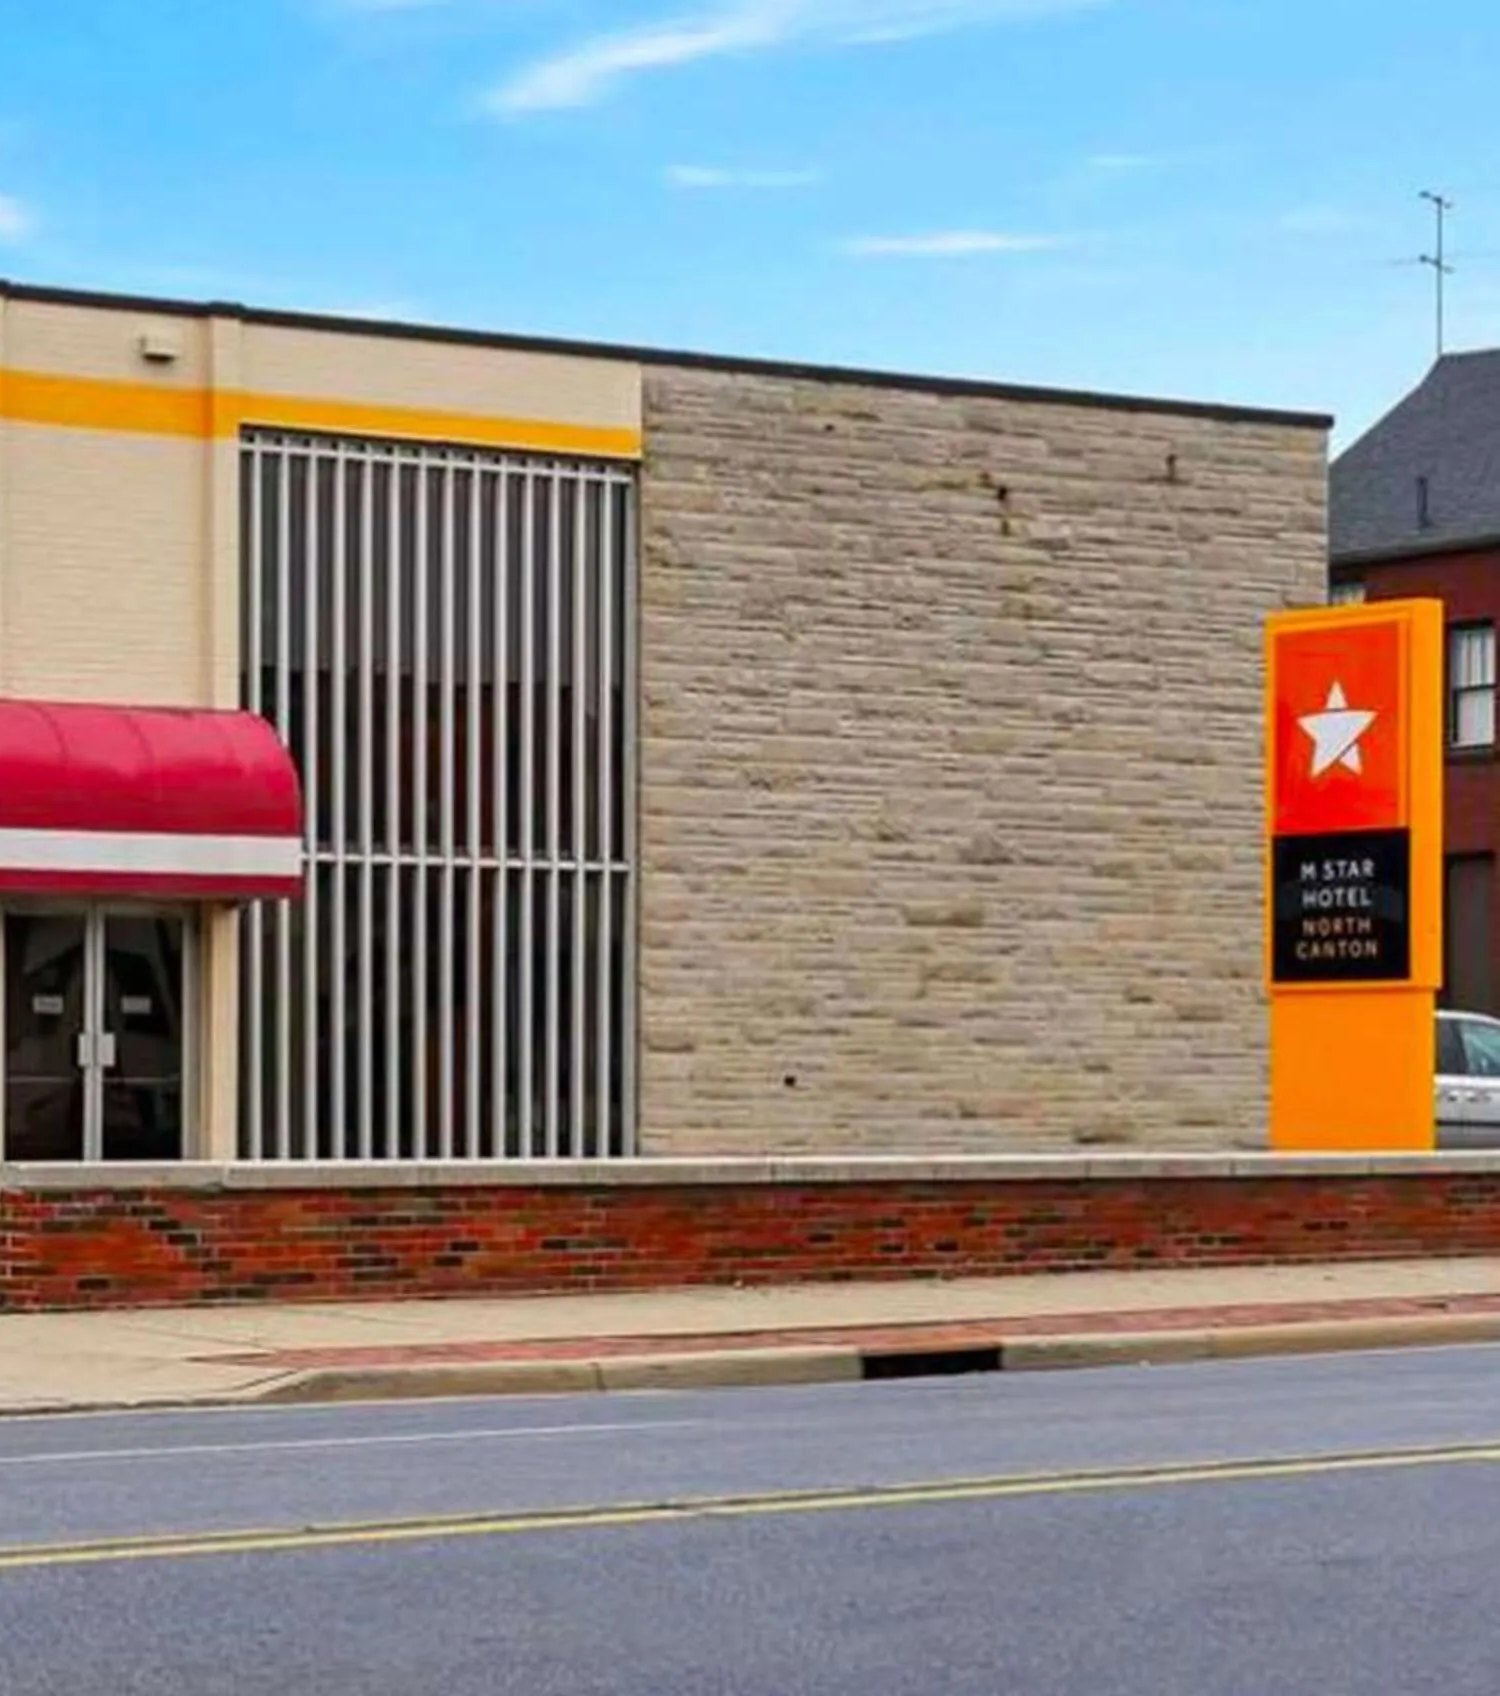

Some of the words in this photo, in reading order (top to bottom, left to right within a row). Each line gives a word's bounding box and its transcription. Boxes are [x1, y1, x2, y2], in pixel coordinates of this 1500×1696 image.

[1301, 862, 1316, 881] M
[1323, 859, 1374, 880] STAR
[1302, 888, 1371, 908] HOTEL
[1302, 917, 1371, 936] NORTH
[1296, 940, 1377, 959] CANTON
